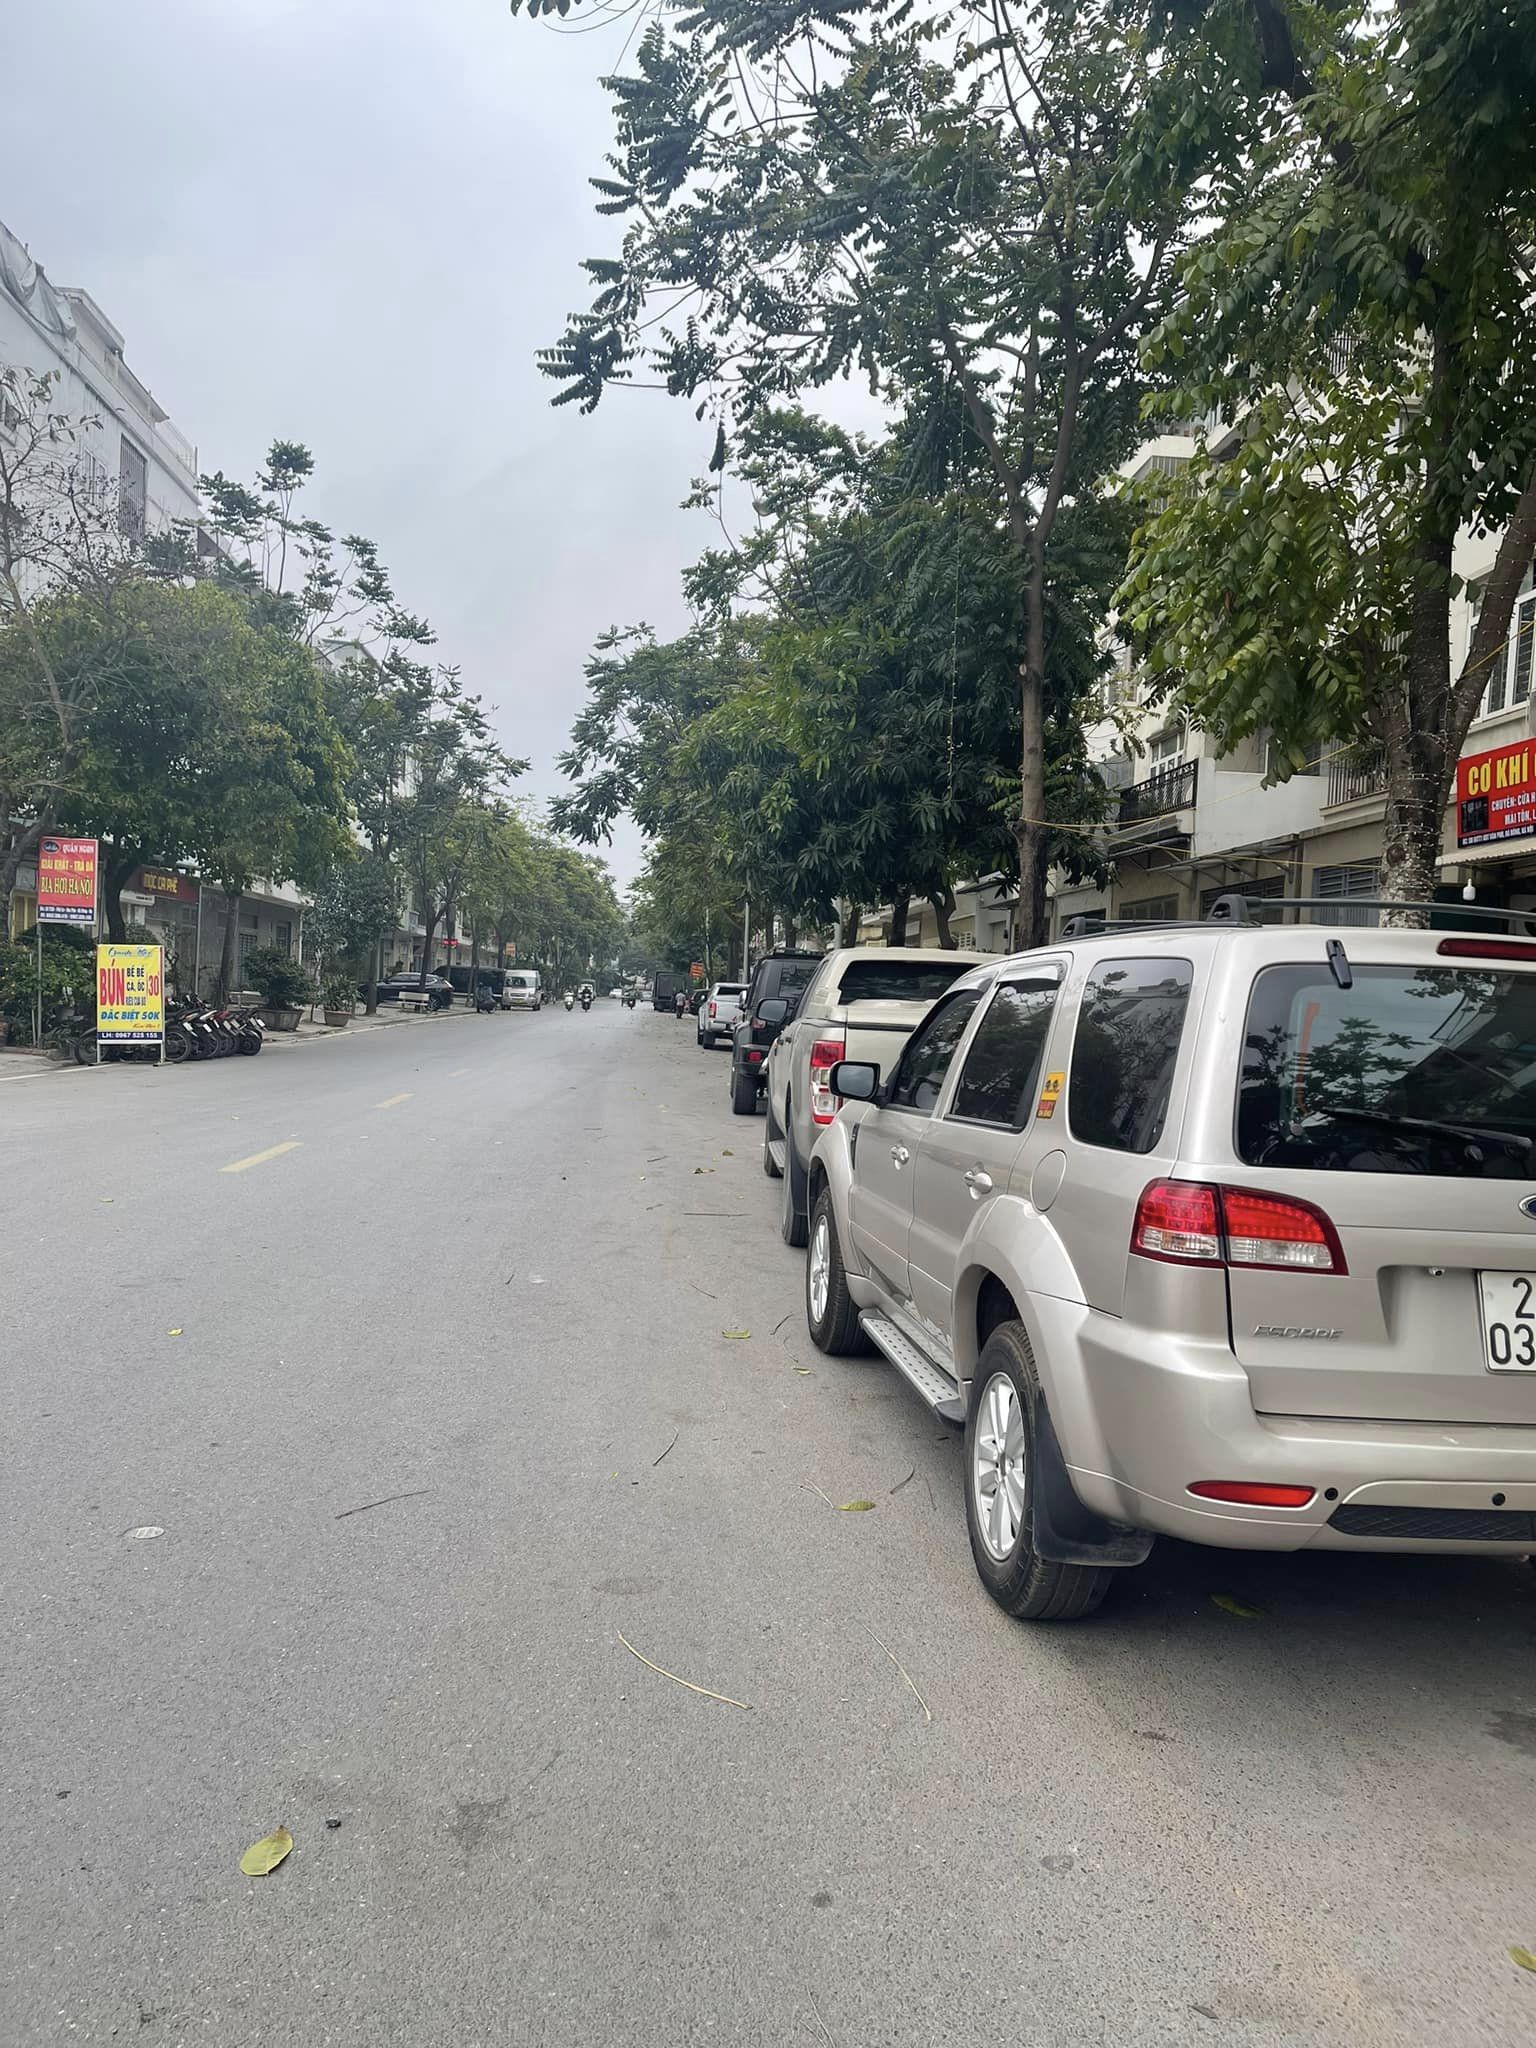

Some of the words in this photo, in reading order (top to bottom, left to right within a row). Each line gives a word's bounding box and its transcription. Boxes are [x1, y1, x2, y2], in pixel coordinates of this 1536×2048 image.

[1468, 758, 1492, 796] CƠ
[1496, 747, 1529, 789] KHÍ
[99, 958, 125, 1006] BÚN
[101, 1009, 120, 1022] ĐẶC
[121, 1009, 140, 1022] BIỆT
[141, 1011, 161, 1020] 50K
